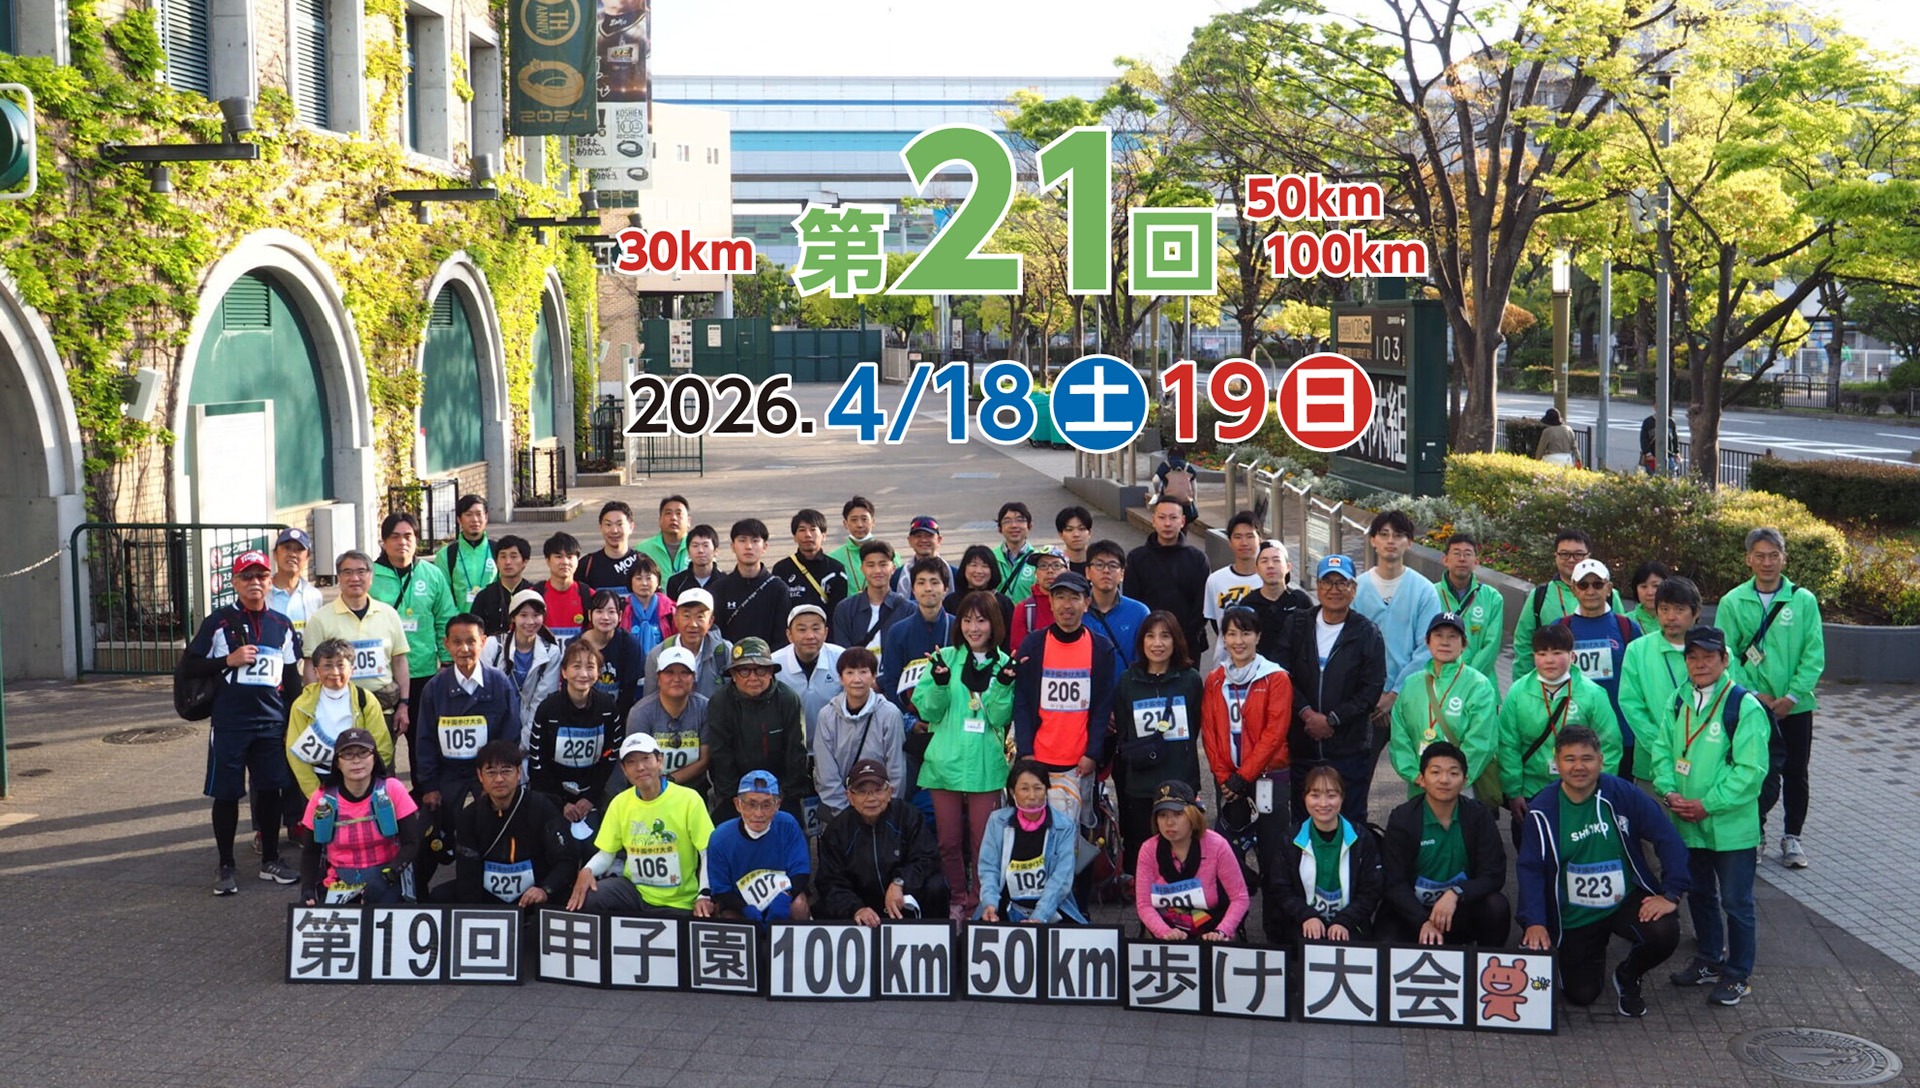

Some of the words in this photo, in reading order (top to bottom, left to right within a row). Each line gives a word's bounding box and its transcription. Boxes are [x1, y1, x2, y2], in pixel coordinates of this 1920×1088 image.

[520, 110, 588, 123] 2024
[616, 109, 643, 117] KOSHIEN
[245, 657, 274, 678] 221
[354, 651, 377, 670] 05
[1047, 681, 1080, 702] 206
[300, 734, 332, 761] 211
[444, 728, 477, 750] 105
[562, 739, 595, 759] 226
[662, 750, 688, 769] 10
[635, 857, 669, 878] 106
[490, 875, 522, 895] 227
[747, 873, 776, 904] 107
[1014, 869, 1047, 891] 102
[1575, 875, 1613, 898] 223
[1313, 898, 1339, 914] 25
[296, 909, 515, 978] 第19回
[540, 916, 748, 989] 甲子園
[1130, 946, 1462, 1022] 歩け大会
